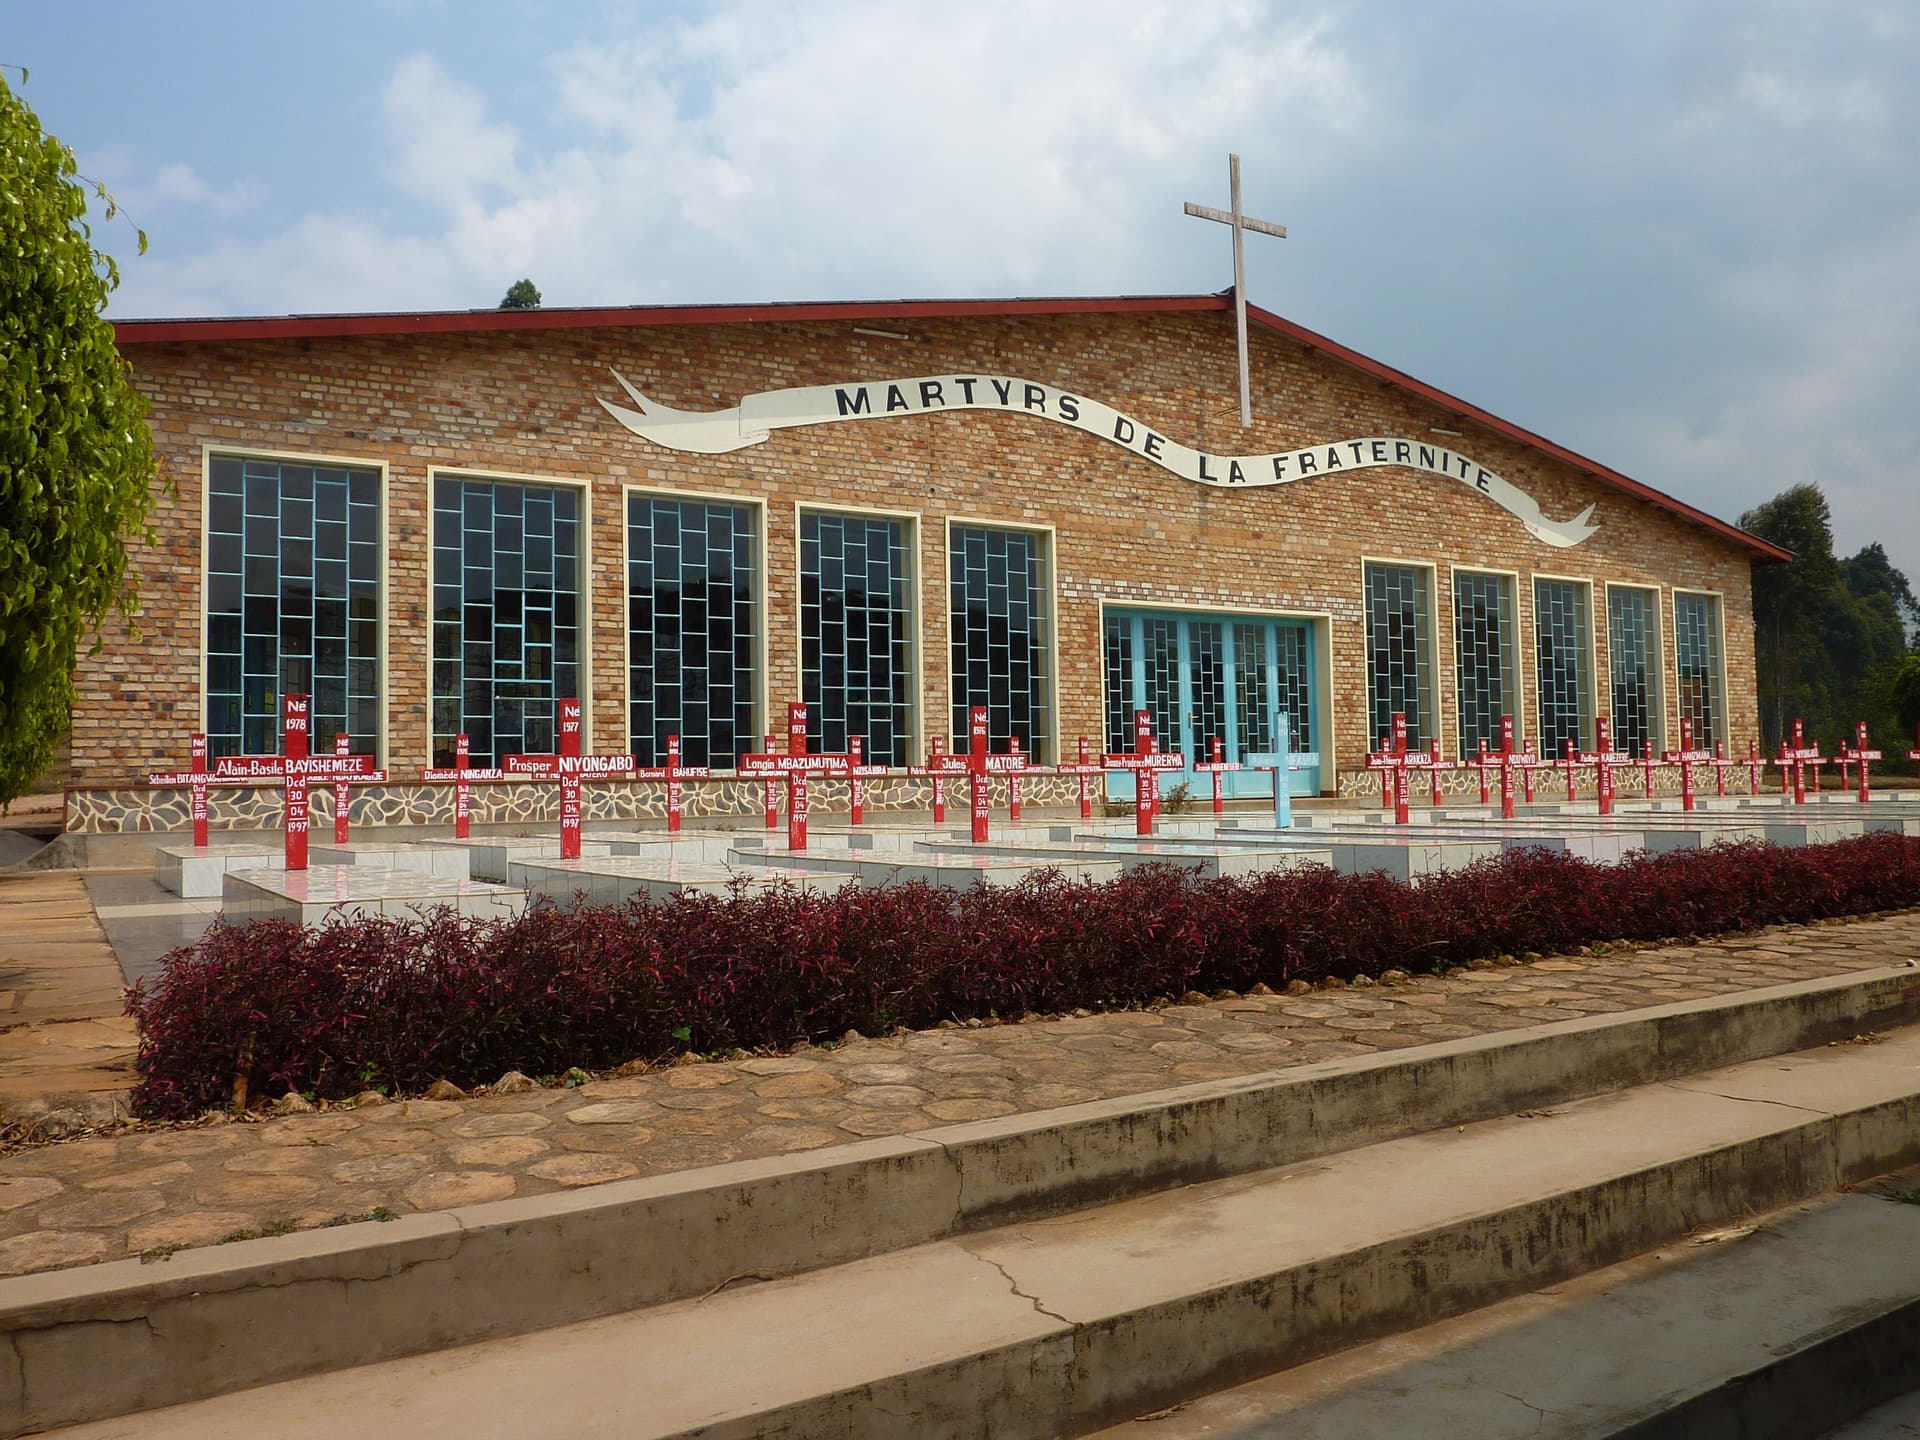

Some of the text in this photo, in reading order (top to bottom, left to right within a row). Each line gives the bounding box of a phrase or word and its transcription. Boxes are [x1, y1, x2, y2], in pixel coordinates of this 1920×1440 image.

[835, 377, 1492, 495] MARTYRS DE LA FRATERNITE
[287, 700, 307, 713] Né
[564, 706, 581, 717] Né
[793, 708, 807, 719] Né
[974, 712, 987, 722] Né
[286, 718, 306, 730] 1978
[563, 722, 579, 732] 1977
[791, 724, 806, 735] 1973
[509, 756, 633, 773] Prosper NIYONGABO
[745, 757, 848, 770] Longin MBAZUMUTIMA
[942, 756, 1025, 770] Jules MATORE
[1144, 754, 1183, 767] MURERWA
[216, 758, 363, 776] Alain-Basile BAYISHEMEZE
[424, 769, 503, 780] Diomède NINGANZA
[793, 775, 807, 785] Dcd
[286, 775, 306, 788] Dcd
[562, 775, 579, 787] Dcd
[290, 790, 302, 801] 30
[565, 789, 576, 799] 30
[795, 788, 804, 796] 30
[565, 804, 576, 814] 04
[795, 801, 804, 809] 04
[290, 806, 304, 816] 04
[563, 818, 579, 828] 1997
[793, 814, 807, 823] 1997
[288, 821, 308, 832] 1997
